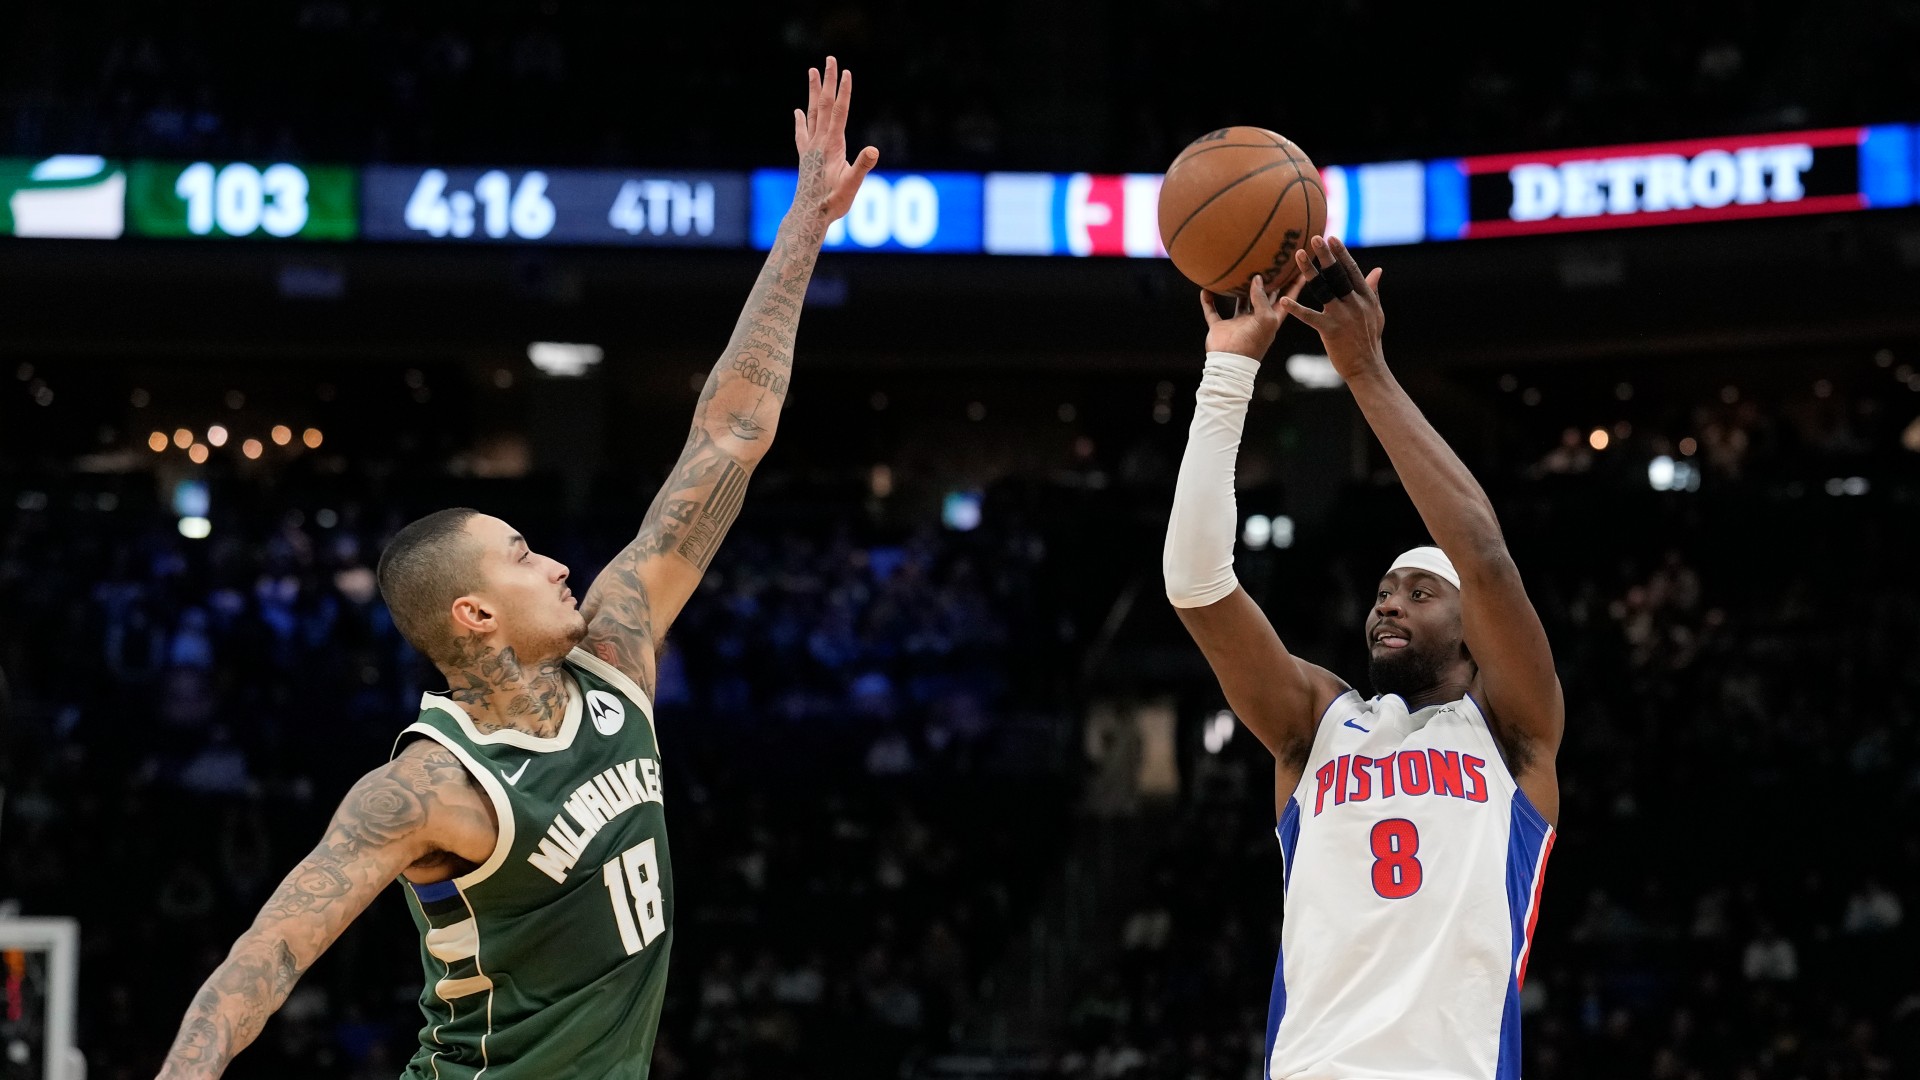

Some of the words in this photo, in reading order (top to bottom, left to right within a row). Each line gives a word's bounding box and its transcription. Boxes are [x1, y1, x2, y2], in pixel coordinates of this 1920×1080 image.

[174, 162, 310, 237] 103
[404, 168, 557, 239] 4:16
[609, 179, 715, 236] 4TH
[1508, 143, 1814, 222] DETROIT
[1313, 748, 1489, 818] PISTONS
[603, 837, 666, 956] 18
[1370, 818, 1423, 900] 8
